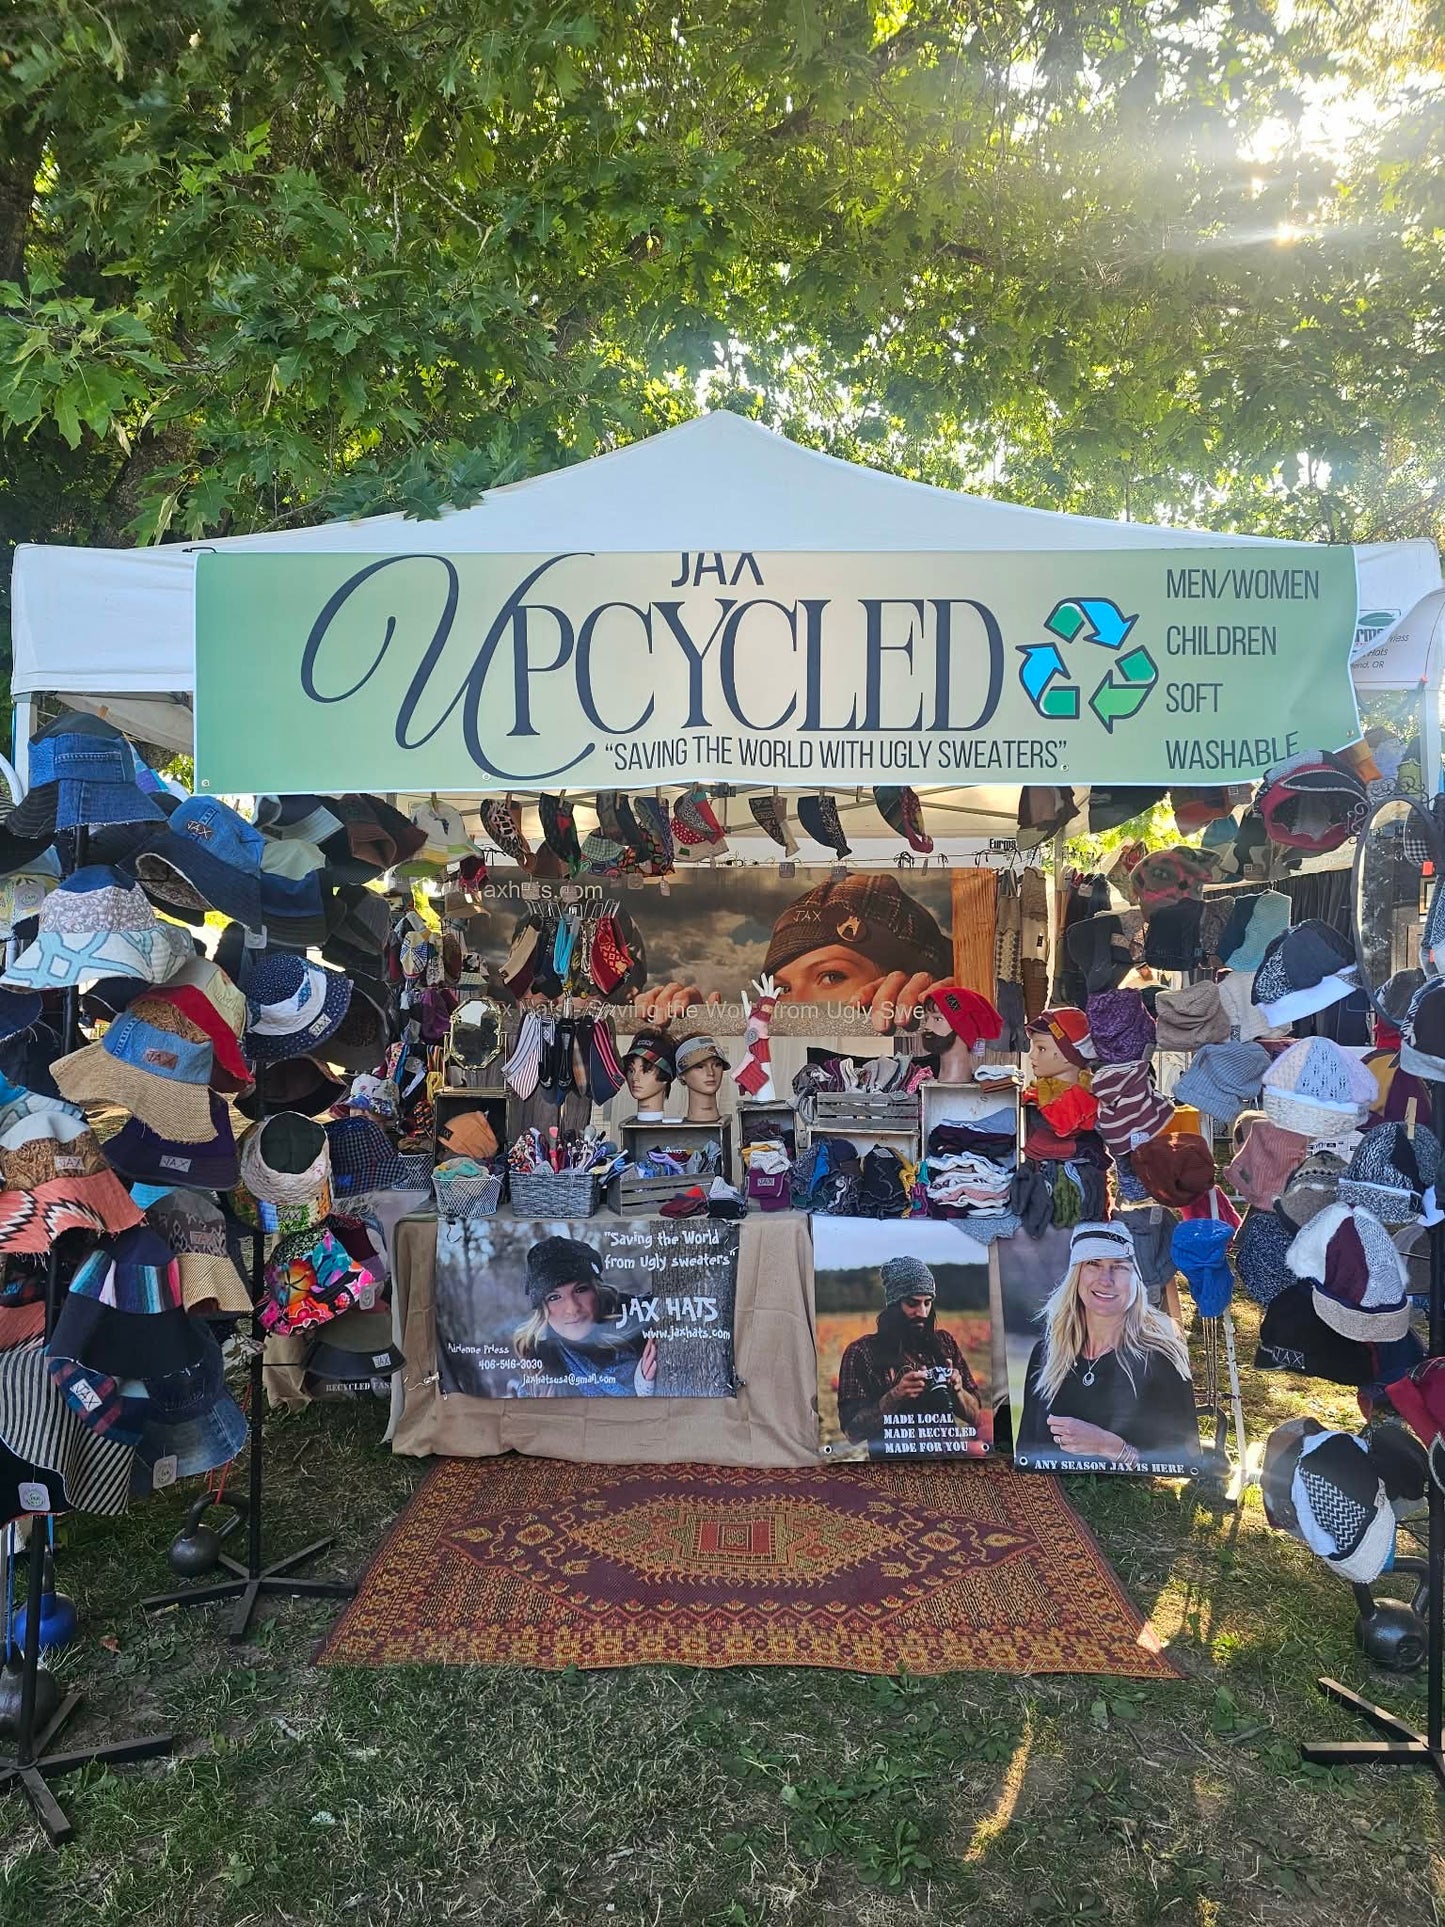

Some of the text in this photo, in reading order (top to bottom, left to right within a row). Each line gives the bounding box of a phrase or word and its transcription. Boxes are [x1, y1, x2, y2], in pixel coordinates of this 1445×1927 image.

[1166, 568, 1319, 600] MEN/WOMEN
[1166, 625, 1277, 656] CHILDREN
[1165, 682, 1224, 713] SOFT
[692, 735, 733, 765] THE
[738, 737, 813, 769] WORLD
[818, 740, 874, 769] WITH
[879, 740, 932, 769] UGLY
[1165, 730, 1300, 770] WASHABLE
[792, 910, 822, 923] JAX
[666, 1000, 698, 1018] the
[773, 1000, 819, 1019] from
[826, 1000, 873, 1023] Ugly
[57, 1156, 83, 1168] JAX
[161, 1157, 189, 1170] JAX
[657, 1230, 679, 1247] the
[682, 1228, 720, 1246] World
[604, 1253, 635, 1270] from
[640, 1252, 667, 1272] Ugly
[615, 1296, 719, 1330] JAX HATS
[642, 1325, 731, 1342] www.jaxhats.com
[478, 1358, 543, 1371] 406-546-3030
[1272, 1346, 1304, 1366] JAX
[372, 1381, 391, 1390] FAS
[73, 1382, 100, 1409] JAX
[883, 1413, 954, 1425] MADE LOCAL
[883, 1426, 977, 1439] MADE RECYCLED
[884, 1440, 969, 1454] MADE FOR YOU
[1034, 1459, 1186, 1474] ANY SEASON JAX IS HERE
